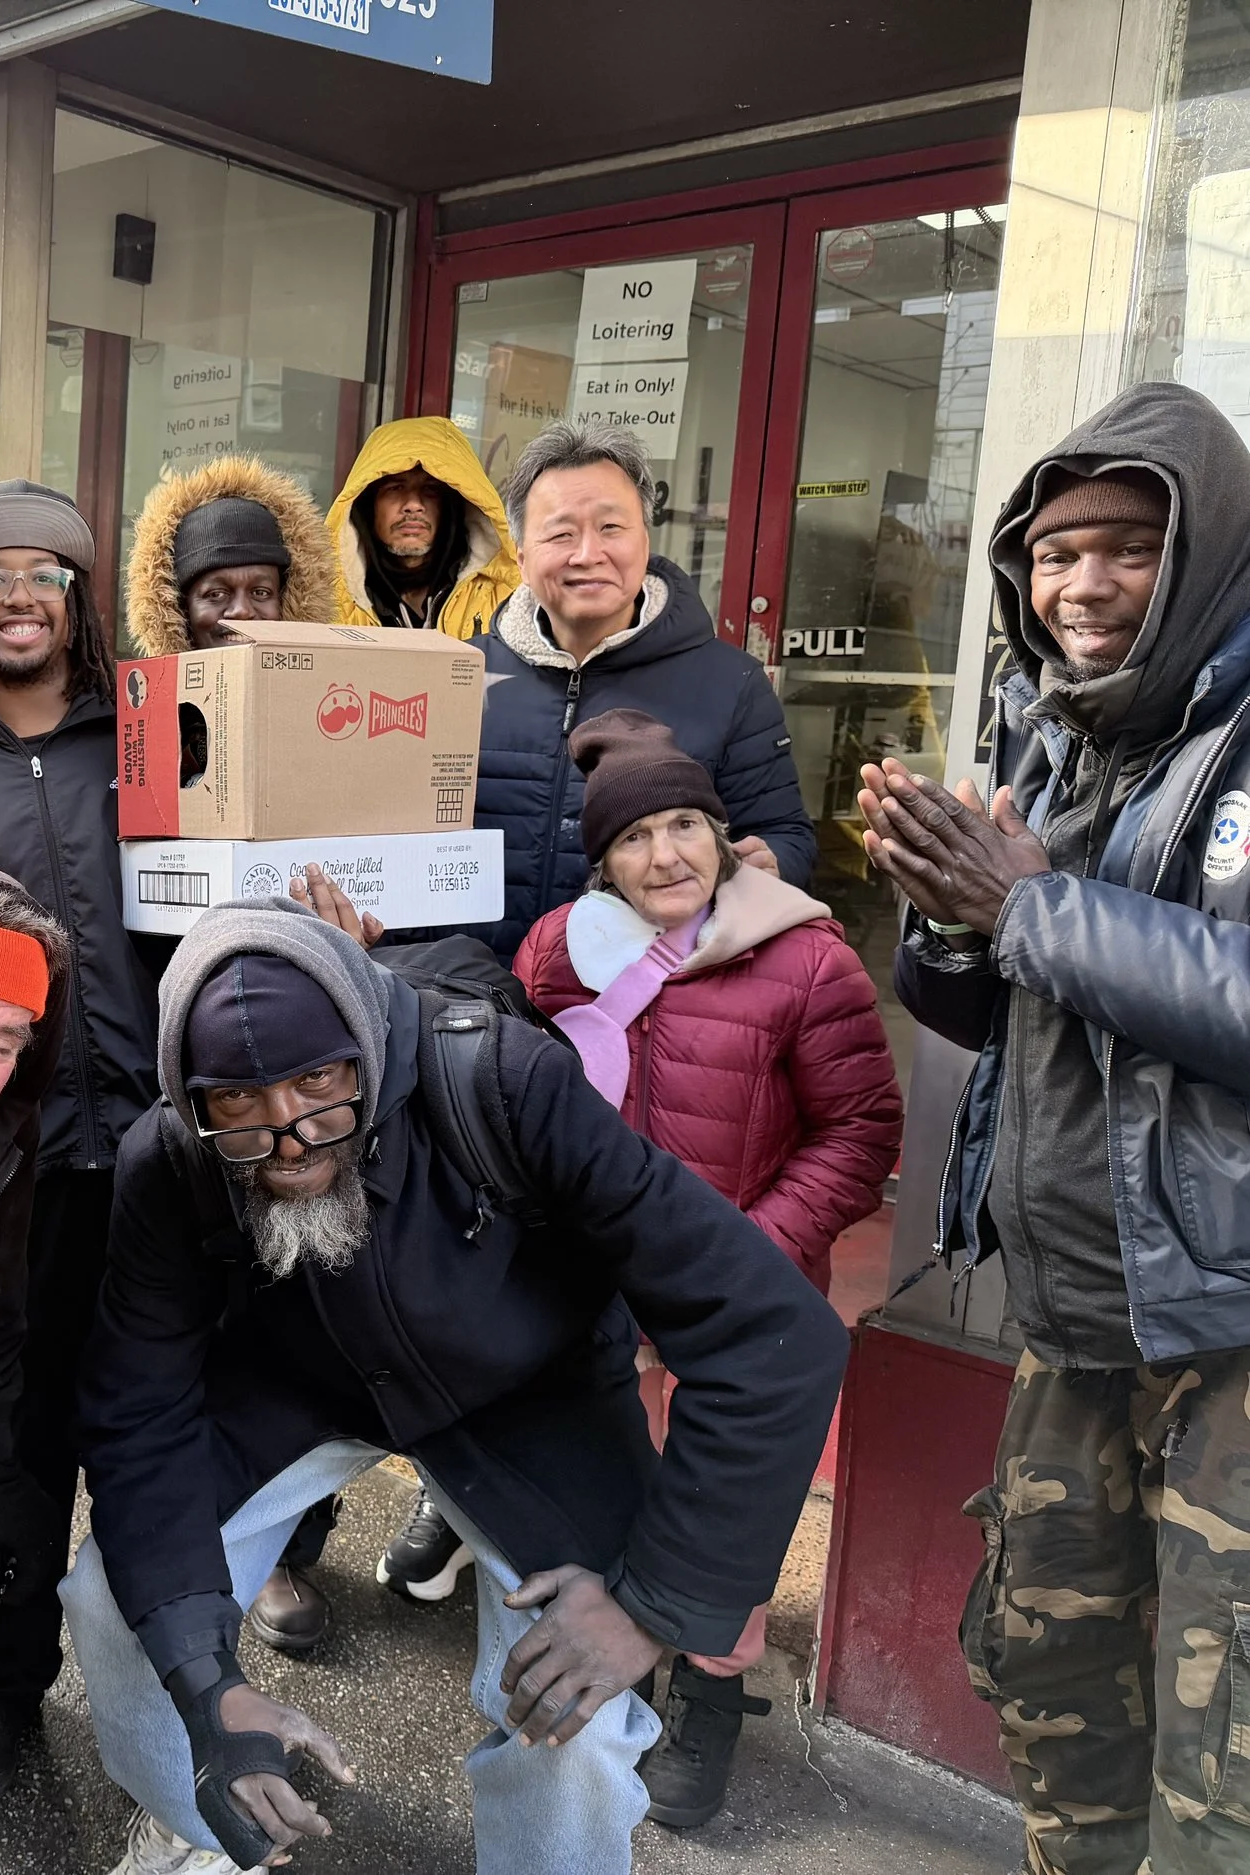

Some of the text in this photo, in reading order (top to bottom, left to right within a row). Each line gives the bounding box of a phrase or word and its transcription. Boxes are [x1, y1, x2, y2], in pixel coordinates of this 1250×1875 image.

[269, 0, 367, 30] -513-3731
[622, 280, 653, 299] NO
[592, 320, 674, 341] Loitering
[586, 378, 675, 396] Eat in Only!
[578, 410, 676, 425] NO Take-Out
[799, 482, 867, 496] WATCH YOUR STEP
[784, 628, 865, 657] PULL
[371, 698, 425, 733] PRINGLES
[124, 723, 133, 785] FLAVOR
[137, 719, 146, 788] BURSTING
[245, 865, 280, 888] NATURAL
[322, 860, 355, 876] Crème
[355, 857, 383, 878] filled
[428, 861, 480, 876] 01/12/2026
[347, 878, 385, 898] Dippers
[351, 896, 380, 909] Spread
